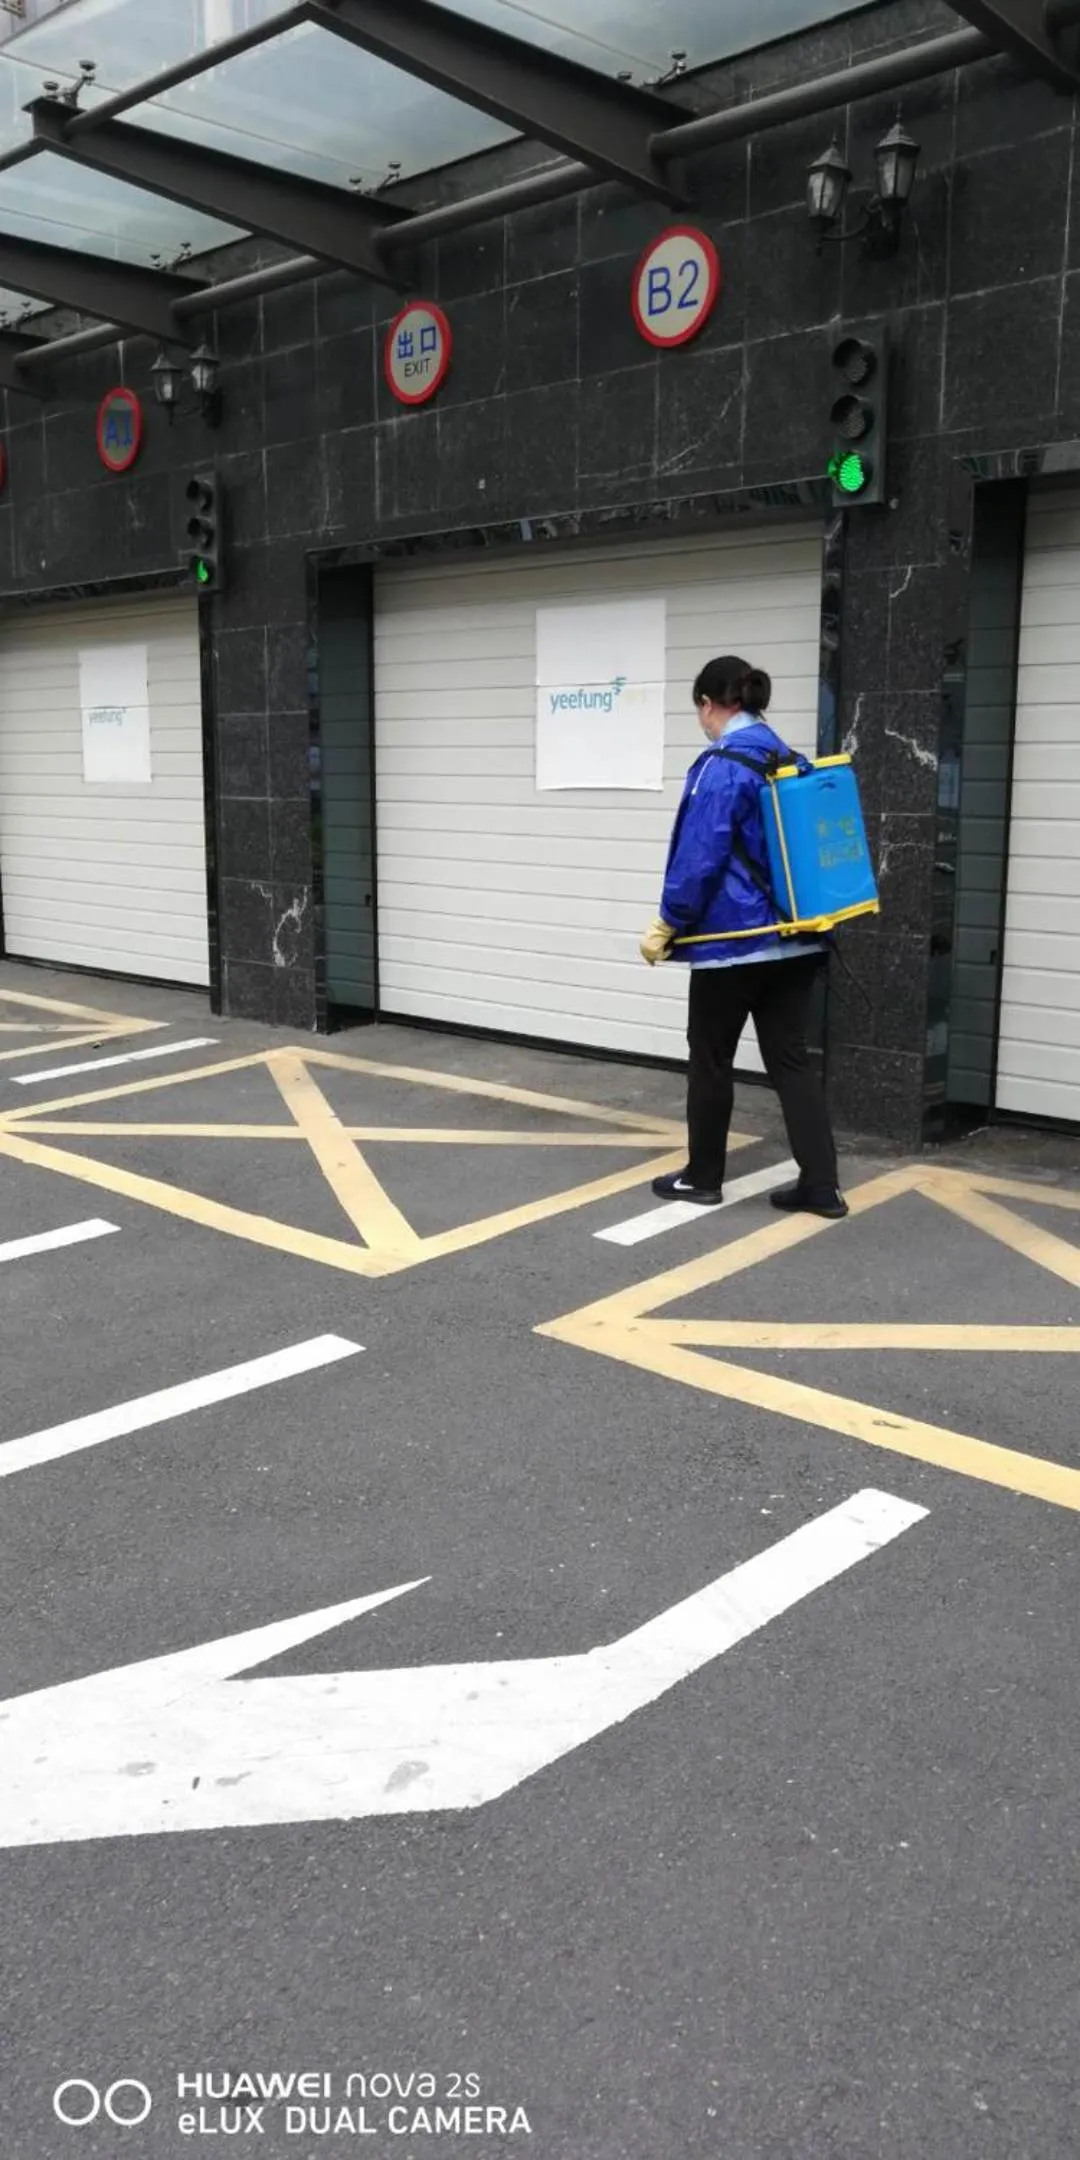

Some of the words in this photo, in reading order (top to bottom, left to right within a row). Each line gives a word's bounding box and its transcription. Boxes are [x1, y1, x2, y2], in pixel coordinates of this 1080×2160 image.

[647, 259, 699, 316] B2
[397, 325, 437, 360] 出口
[404, 358, 431, 378] EXIT
[550, 688, 613, 714] yeefung
